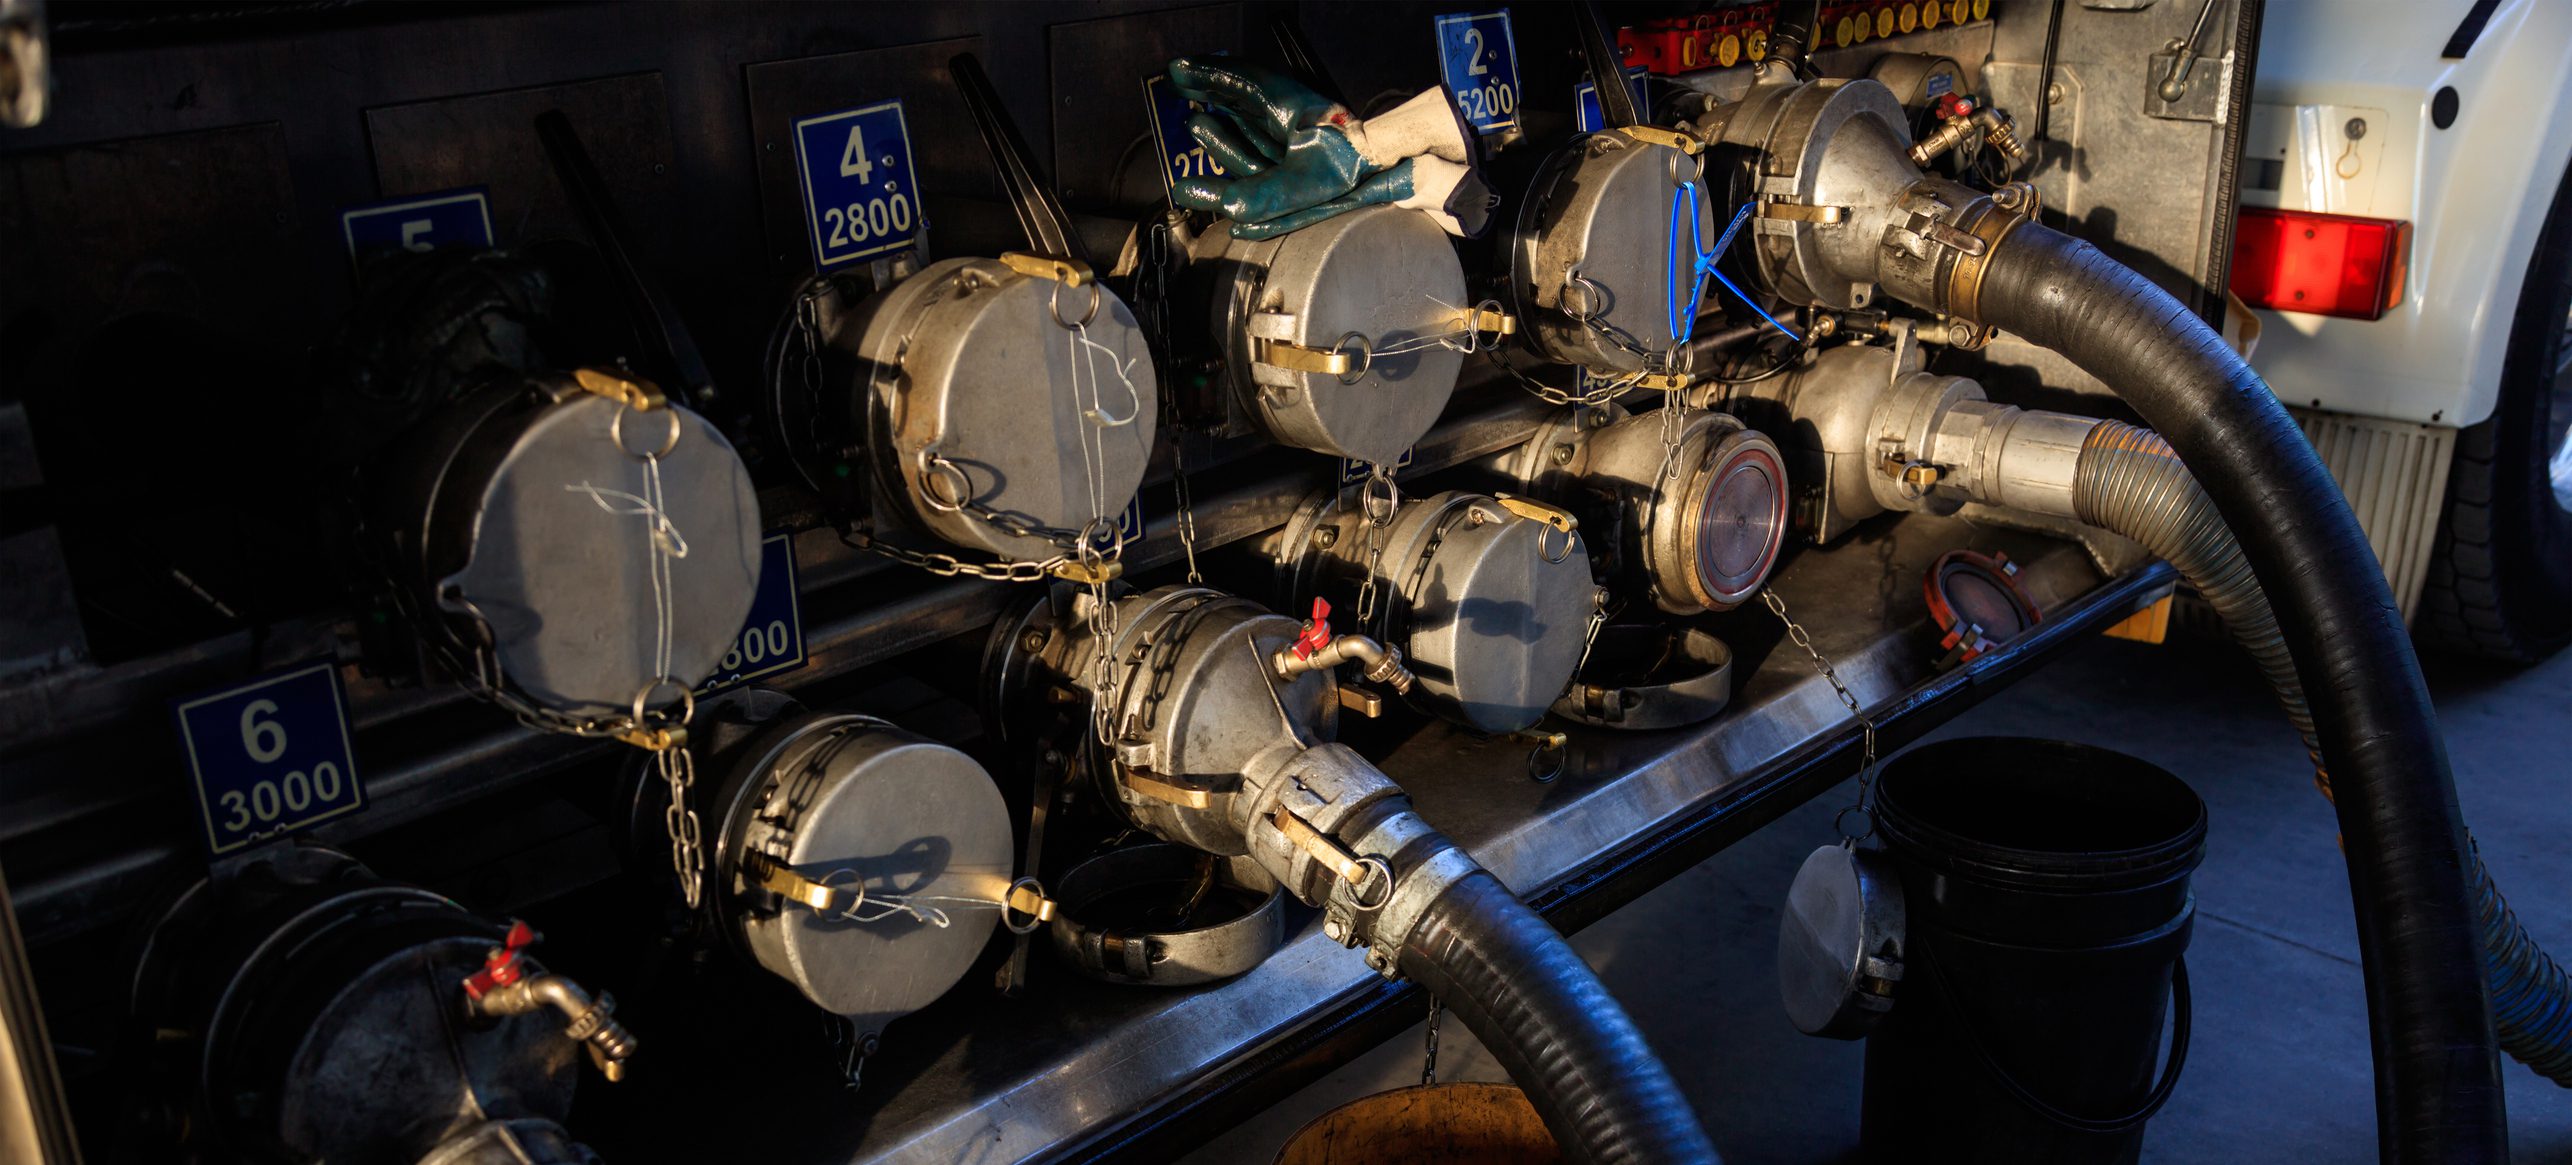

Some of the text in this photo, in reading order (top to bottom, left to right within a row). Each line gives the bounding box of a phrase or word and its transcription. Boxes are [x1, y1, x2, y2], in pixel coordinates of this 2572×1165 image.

[1464, 27, 1488, 77] 2
[1457, 83, 1514, 121] 5200
[840, 124, 873, 186] 4
[824, 192, 911, 249] 2800
[708, 619, 789, 678] 800
[239, 698, 288, 764] 6
[219, 760, 341, 833] 3000
